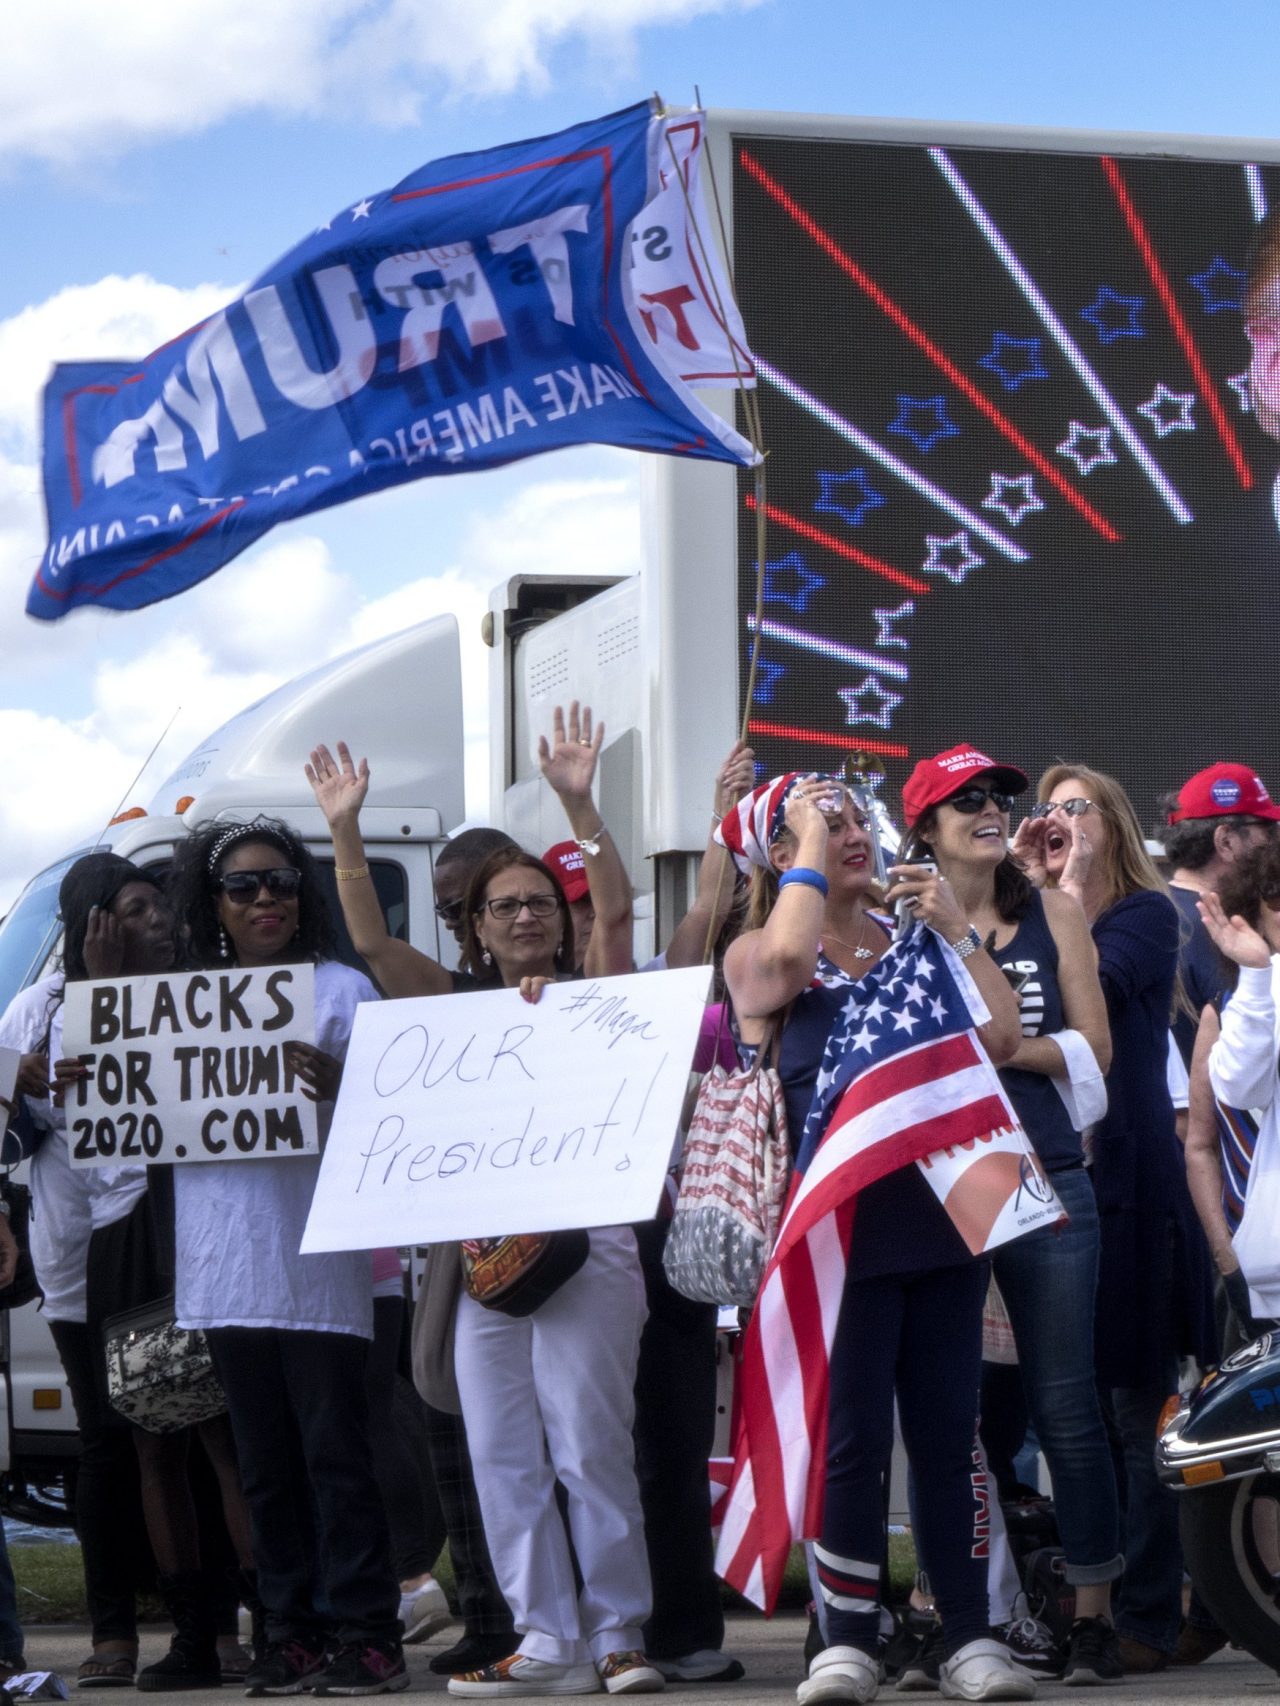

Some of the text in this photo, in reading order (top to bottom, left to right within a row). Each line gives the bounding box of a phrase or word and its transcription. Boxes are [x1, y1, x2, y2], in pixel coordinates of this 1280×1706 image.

[90, 970, 295, 1045] BLACKS
[77, 1050, 157, 1107] FOR
[373, 1024, 535, 1098] OUR
